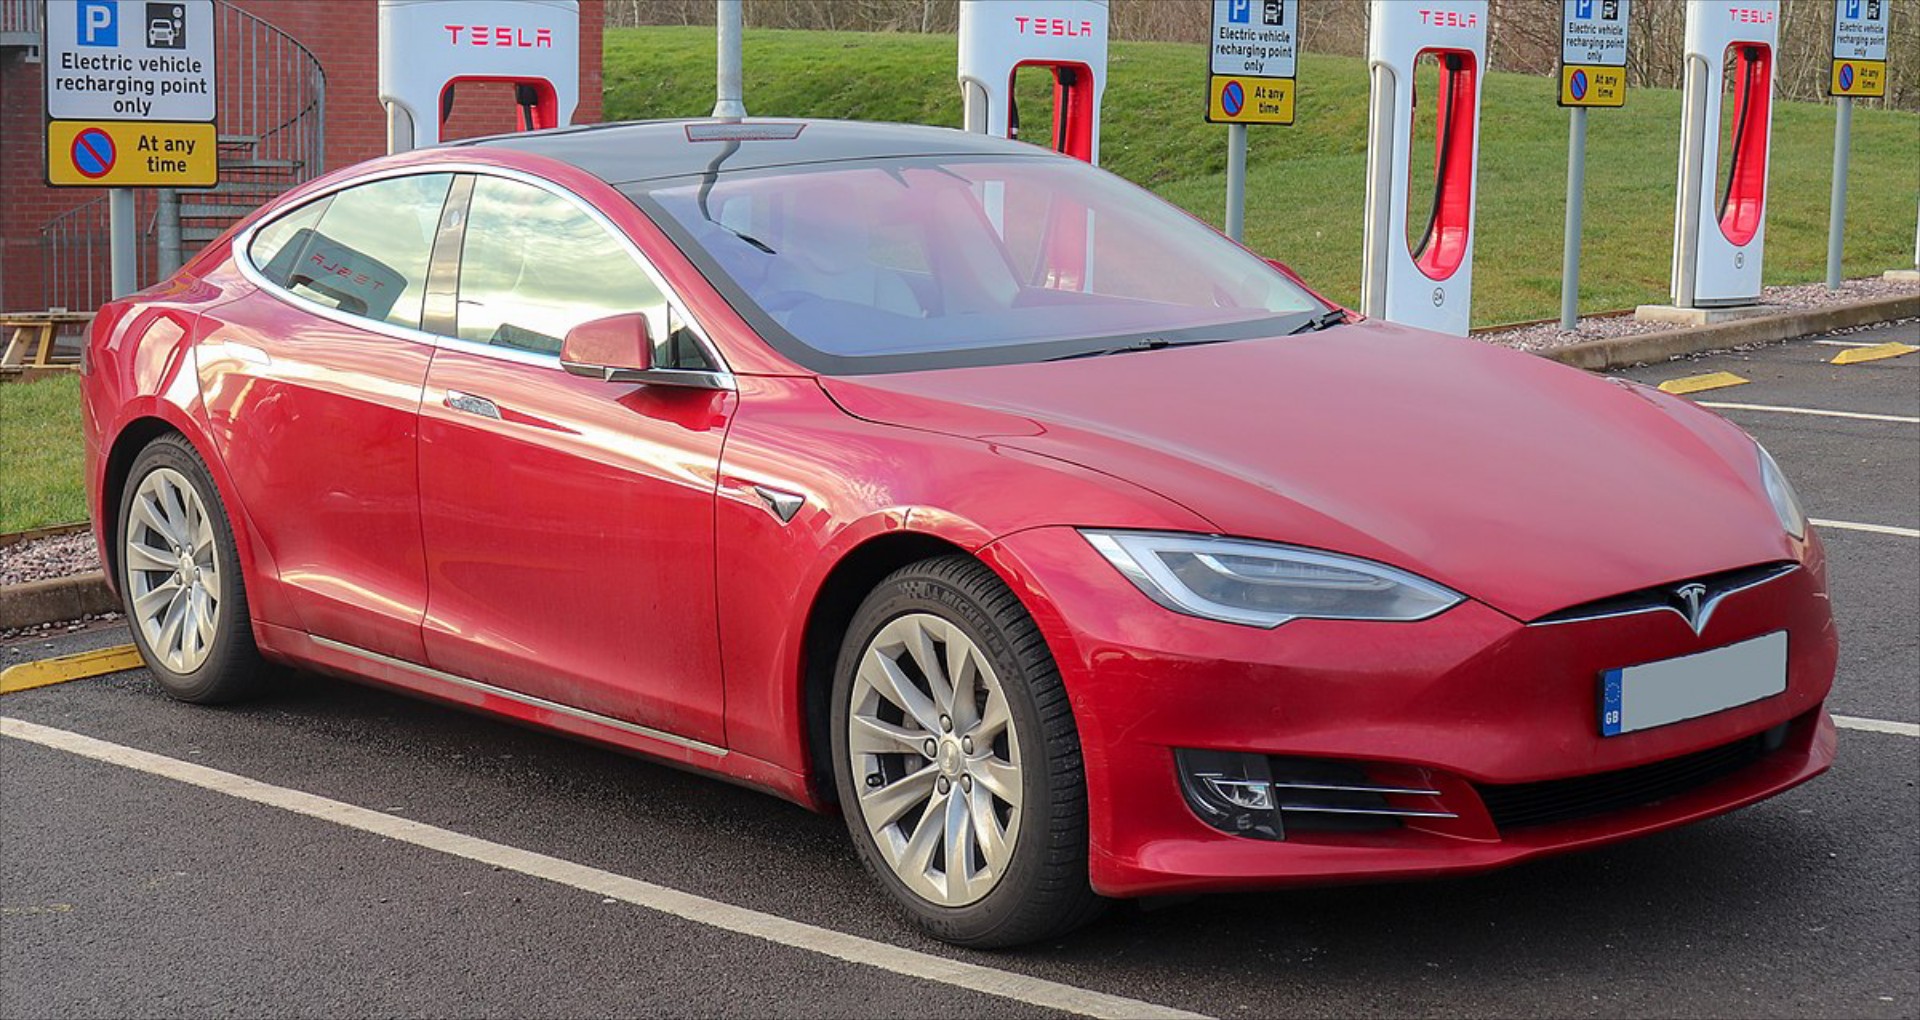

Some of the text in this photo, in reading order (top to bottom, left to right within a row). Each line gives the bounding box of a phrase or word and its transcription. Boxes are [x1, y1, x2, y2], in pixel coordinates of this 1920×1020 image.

[1233, 0, 1247, 20] P
[1729, 9, 1773, 23] TESLA
[86, 5, 111, 42] P
[1015, 17, 1091, 37] TESLA
[1419, 10, 1476, 28] TESLA
[444, 25, 552, 48] TESLA
[1220, 27, 1290, 43] Electric vehicle
[1569, 22, 1623, 35] Electric vehicle
[1216, 43, 1292, 59] recharging point
[1566, 36, 1625, 50] recharging point
[62, 52, 202, 73] Electric vehicle
[1587, 50, 1602, 62] only
[1244, 59, 1264, 73] only
[56, 75, 207, 95] recharging point
[1595, 74, 1618, 86] At any
[1255, 86, 1285, 101] At any
[1598, 88, 1613, 98] time
[113, 97, 152, 117] only
[1258, 101, 1279, 114] time
[137, 134, 196, 155] At any
[147, 156, 187, 173] time
[1605, 710, 1619, 725] GB
